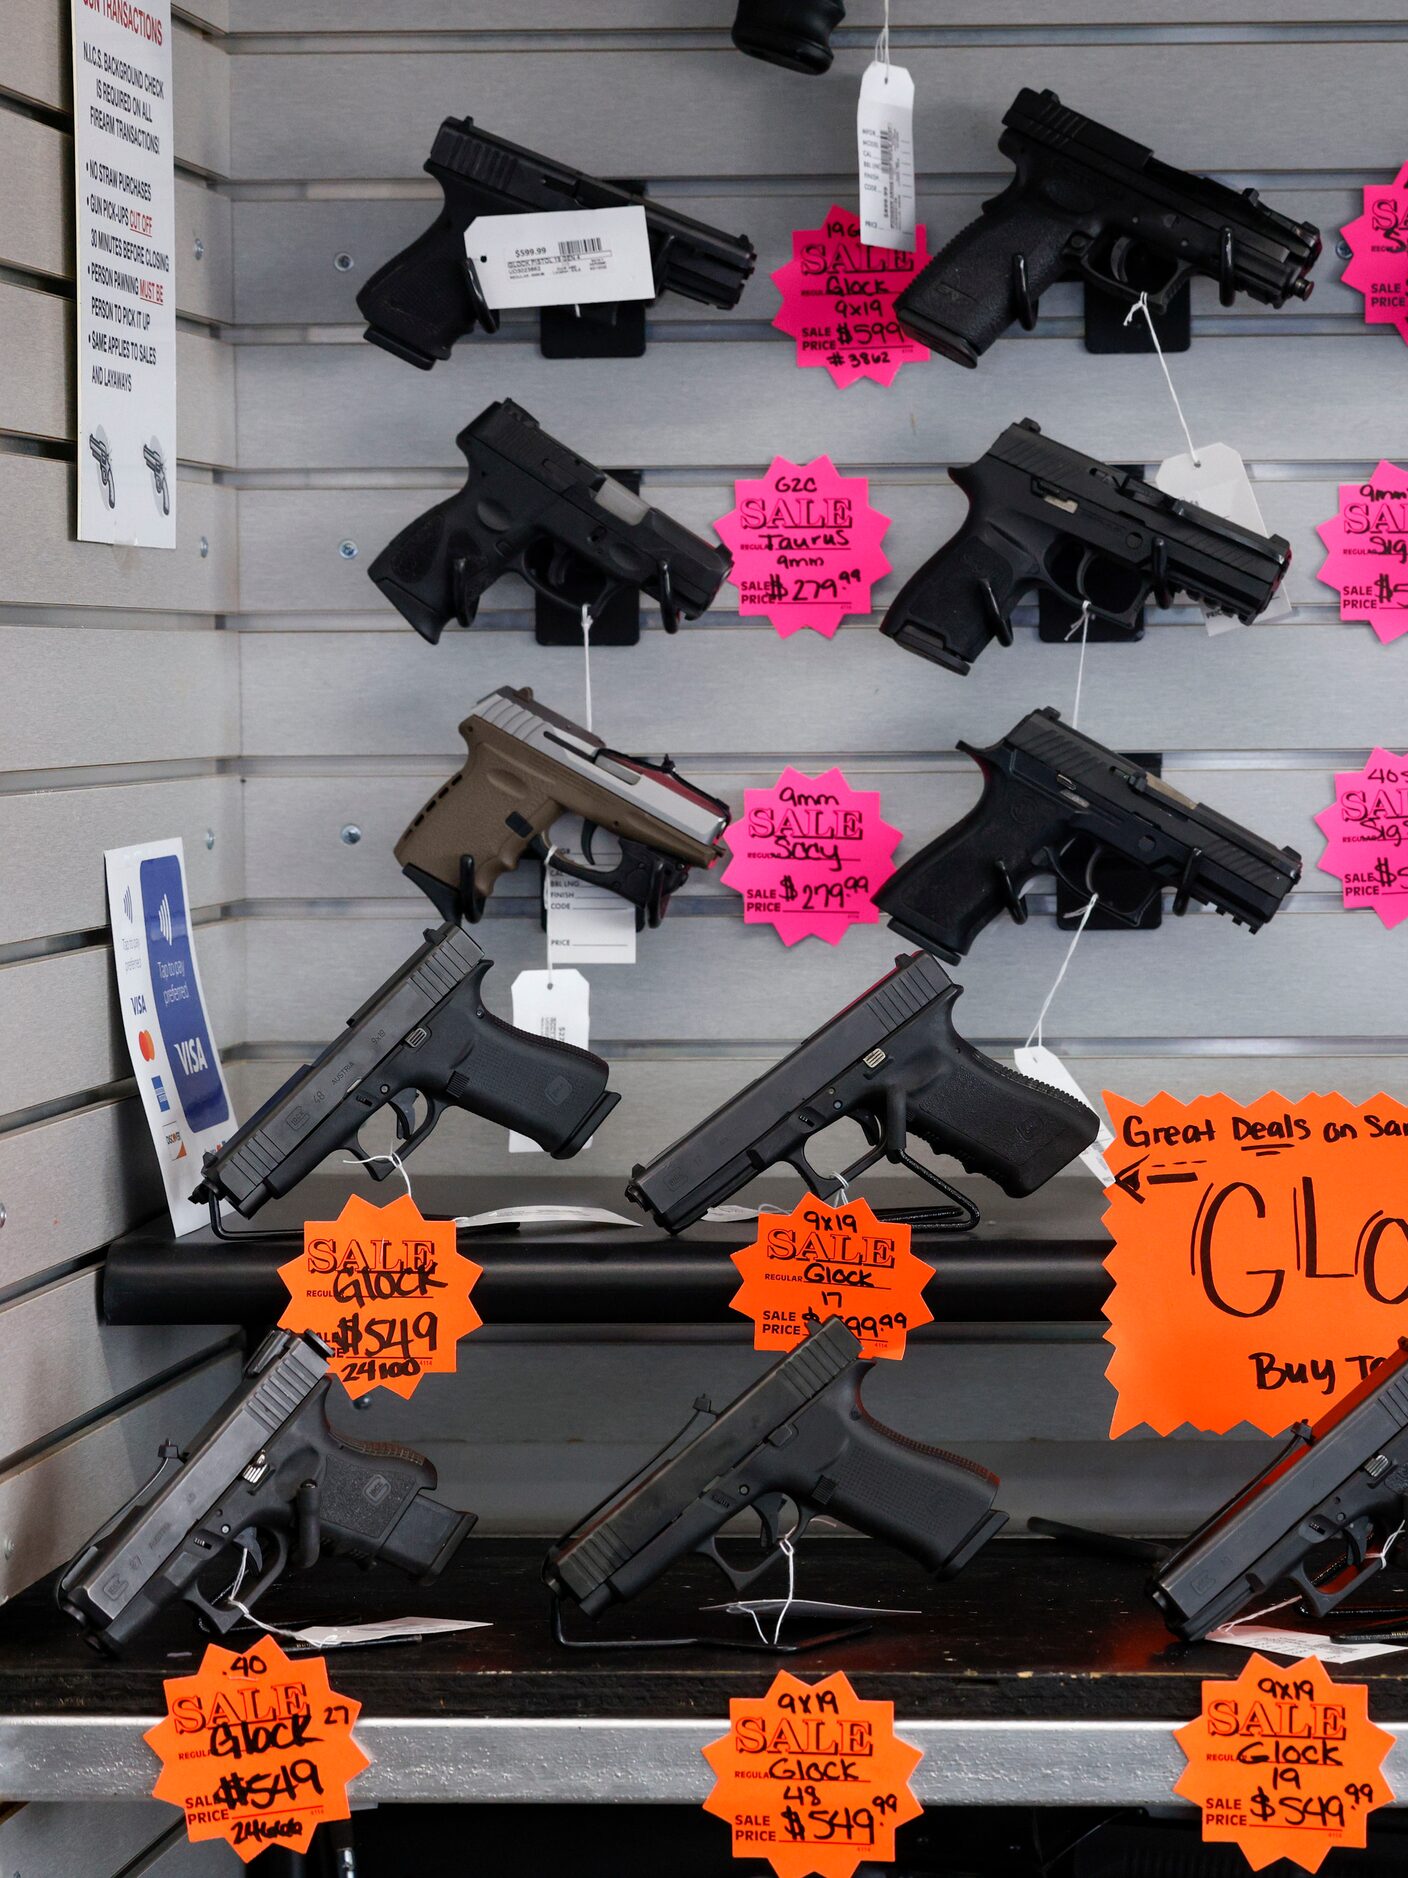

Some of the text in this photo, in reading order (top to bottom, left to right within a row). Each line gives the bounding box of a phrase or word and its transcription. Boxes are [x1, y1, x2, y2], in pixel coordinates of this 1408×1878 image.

[84, 41, 164, 100] N.I.C.S. BACKGROUND CHECK
[96, 79, 152, 122] IS REQUIRED ON ALL
[90, 105, 115, 136] FIREARM
[90, 159, 151, 202] NO STRAW PURCHASES
[90, 194, 152, 234] GUN PICK-UPS CUT OFF
[91, 228, 169, 272] 30 MINUTES BEFORE CLOSING
[515, 247, 546, 257] $599.99
[91, 262, 163, 302] PERSON PAWNING MUST BE
[826, 276, 889, 297] Glock
[92, 296, 150, 331] PERSON TO PICK IT UP
[802, 327, 831, 337] SALE
[92, 330, 156, 365] SAME APPLIES TO SALES
[803, 341, 836, 350] PRICE
[92, 364, 131, 392] AND LAYAWAYS
[740, 497, 852, 529] SALE
[759, 530, 849, 550] Taurus
[1343, 586, 1372, 596] SALE
[1343, 600, 1377, 609] PRICE
[780, 787, 839, 806] 9mm
[749, 807, 862, 840] SALE
[747, 889, 776, 899] SALE
[747, 903, 780, 912] PRICE
[130, 995, 147, 1015] VISA
[163, 984, 189, 1006] preferred
[173, 1037, 208, 1076] VISA
[331, 1062, 354, 1085] AUSTRIA
[1122, 1116, 1215, 1148] Great
[1232, 1113, 1312, 1141] Deals
[1323, 1121, 1357, 1142] on
[308, 1239, 435, 1274] SALE
[767, 1229, 895, 1268] SALE
[333, 1262, 448, 1308] Glock
[765, 1263, 875, 1287] REGULAR Glock
[763, 1311, 795, 1321] SALE
[335, 1312, 438, 1360] $549
[763, 1324, 800, 1335] PRICE
[1249, 1352, 1334, 1394] Buy
[172, 1682, 311, 1734] SALE
[324, 1706, 349, 1725] 27
[1208, 1700, 1346, 1740] SALE
[210, 1713, 323, 1759] Glock
[736, 1717, 873, 1757] SALE
[1237, 1740, 1343, 1766] Glock
[769, 1758, 859, 1781] Glock
[1273, 1768, 1300, 1790] 19
[783, 1785, 821, 1806] 48
[1206, 1798, 1241, 1809] SALE
[735, 1815, 770, 1826] SALE
[1206, 1814, 1247, 1825] PRICE
[735, 1830, 776, 1841] PRICE
